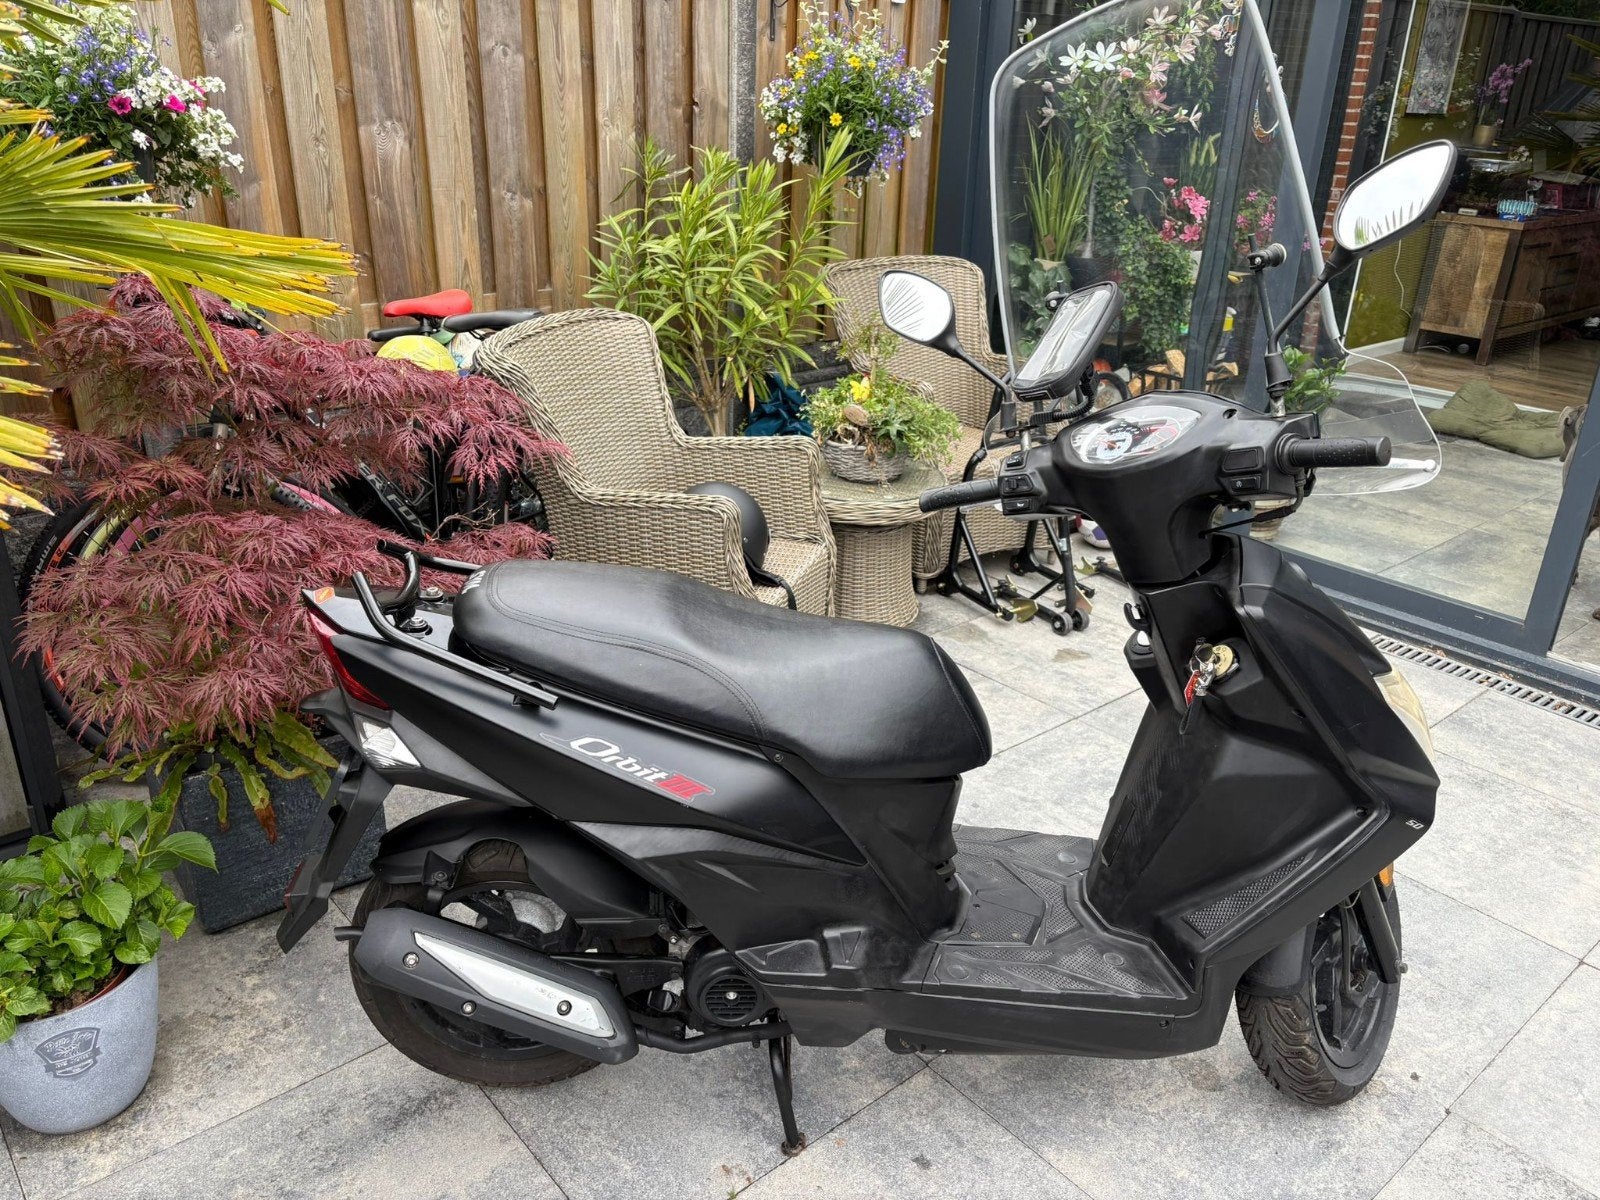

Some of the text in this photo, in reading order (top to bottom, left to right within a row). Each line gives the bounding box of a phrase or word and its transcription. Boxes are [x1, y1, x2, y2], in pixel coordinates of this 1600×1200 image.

[386, 493, 432, 537] FOX
[569, 736, 669, 783] Orbit
[1405, 819, 1425, 830] 50
